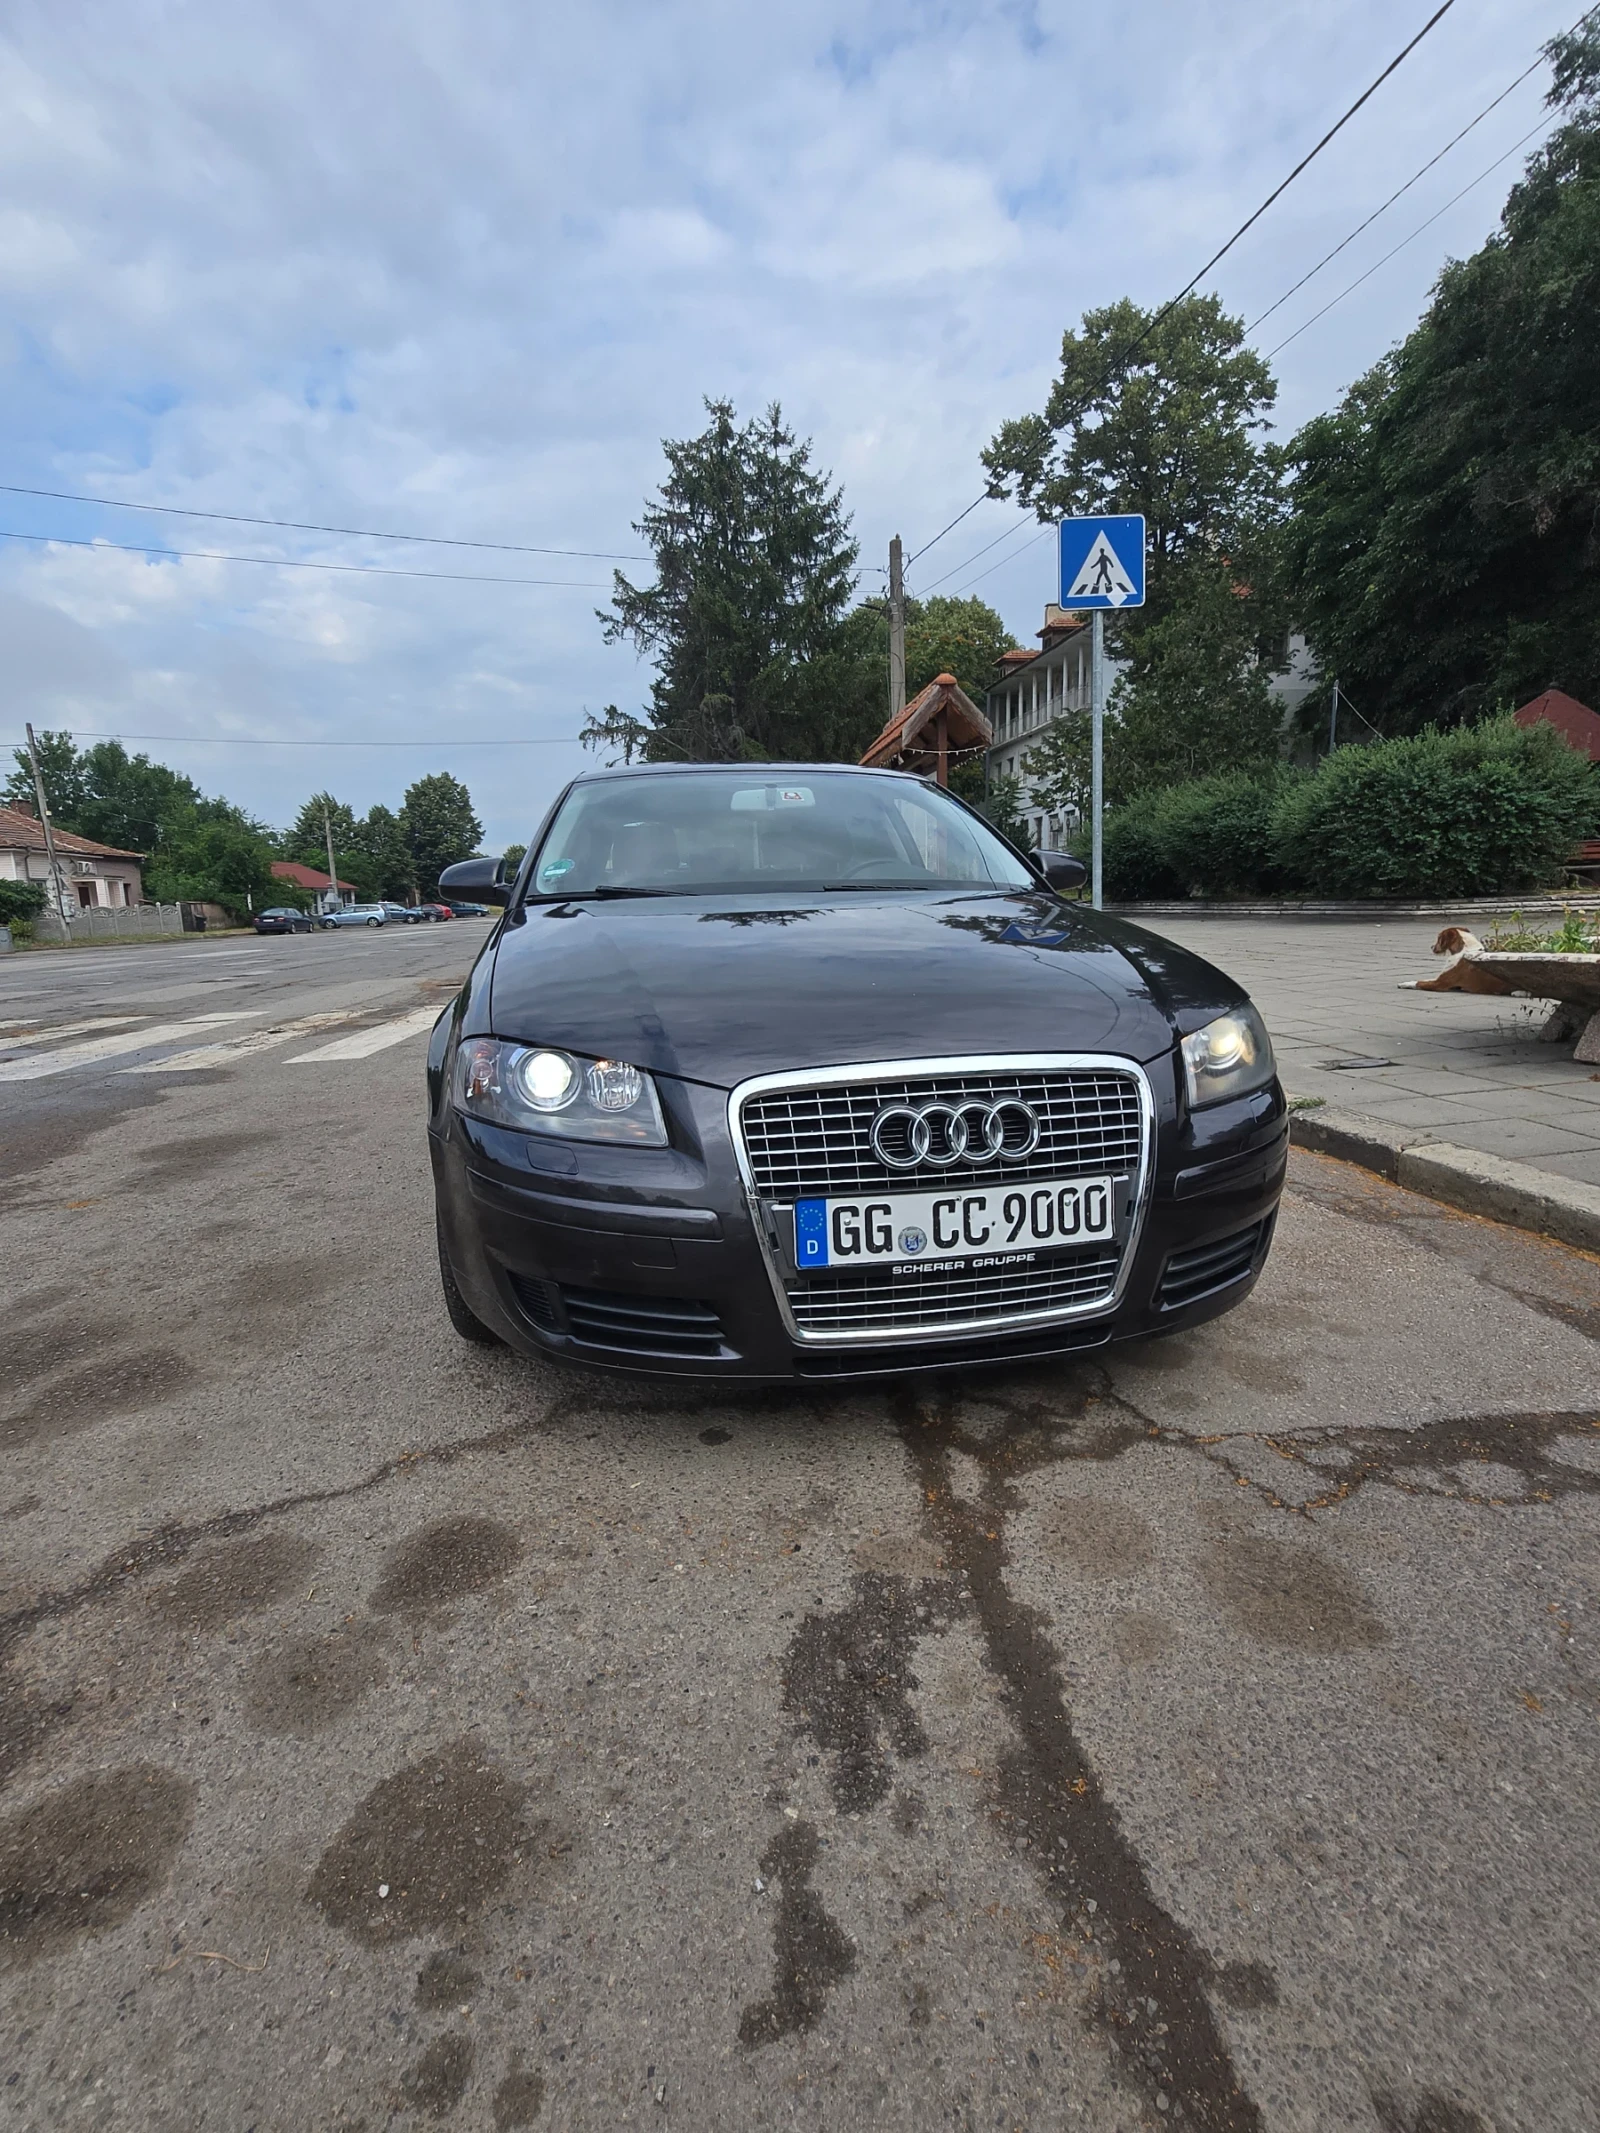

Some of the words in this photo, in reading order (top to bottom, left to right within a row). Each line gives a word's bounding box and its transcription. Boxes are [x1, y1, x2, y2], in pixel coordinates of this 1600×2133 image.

[832, 1203, 892, 1256] GG
[932, 1196, 989, 1249] CC
[1003, 1184, 1107, 1243] 9000
[807, 1240, 818, 1255] D
[892, 1260, 965, 1275] SCHERER
[972, 1253, 1036, 1268] GRUPPE
